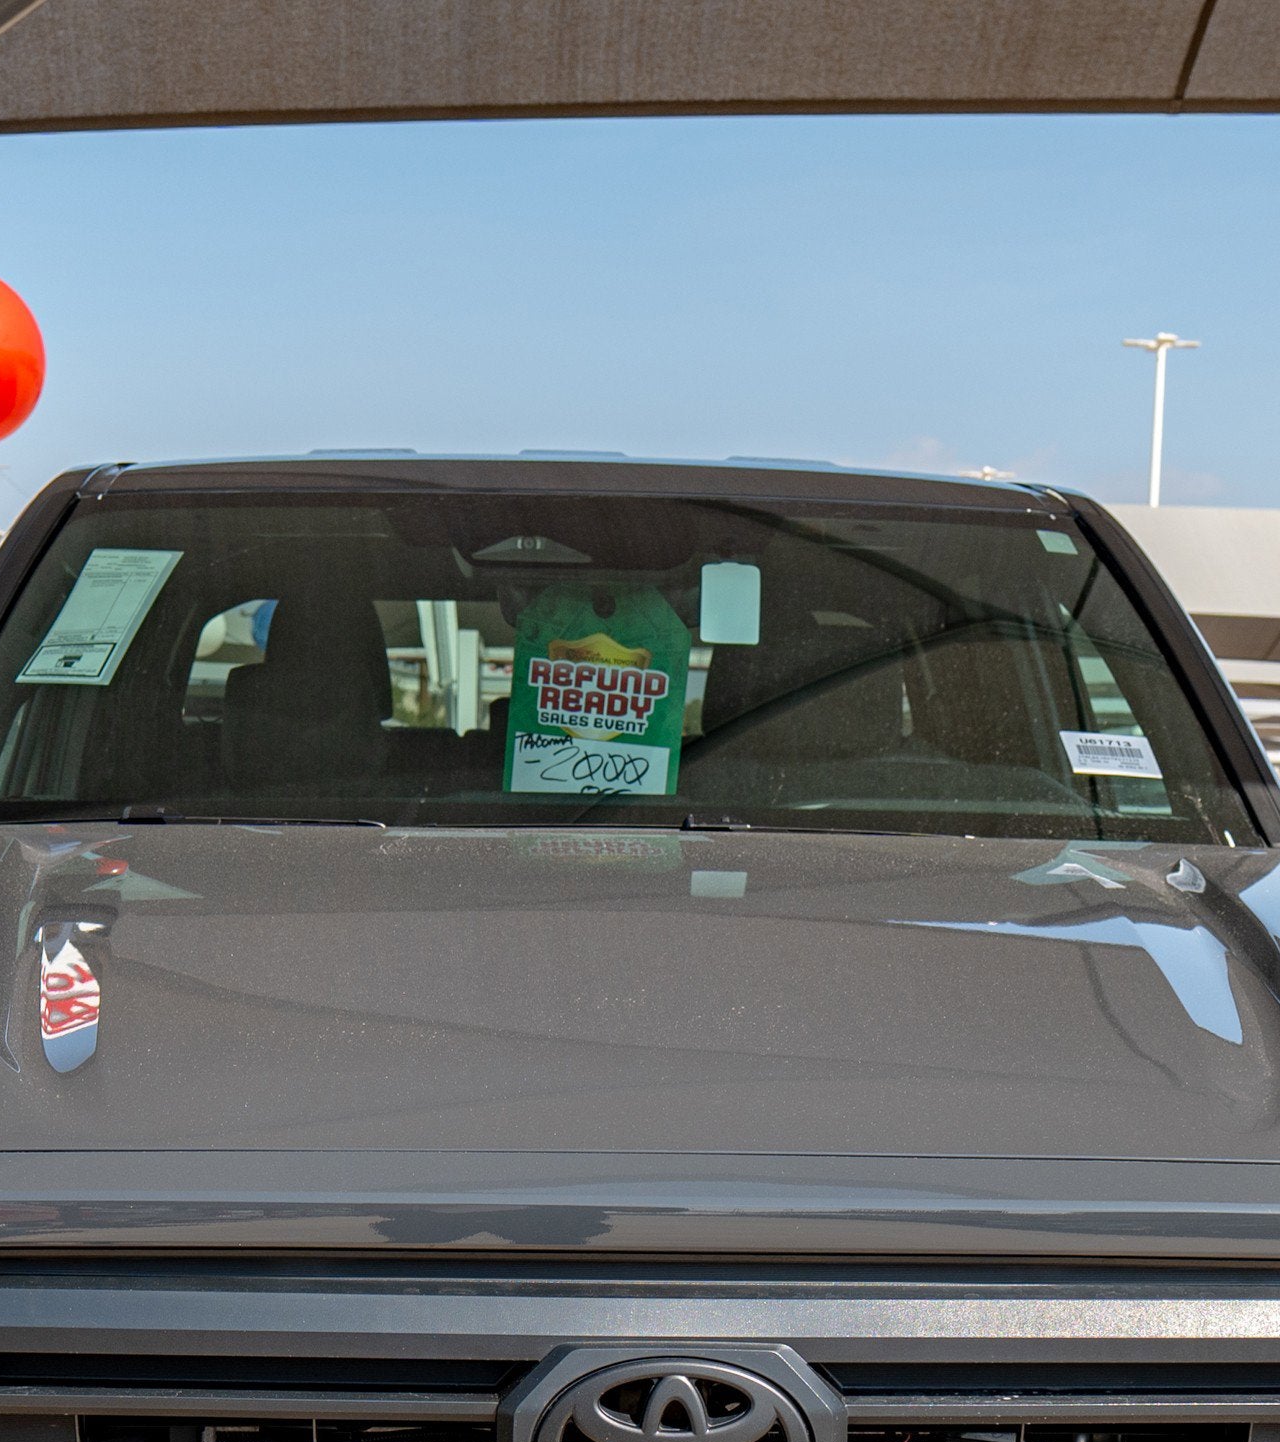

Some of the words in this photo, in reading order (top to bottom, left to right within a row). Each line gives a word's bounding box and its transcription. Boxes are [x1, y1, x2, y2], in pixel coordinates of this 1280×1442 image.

[530, 659, 668, 697] REFUND
[539, 686, 653, 720] READY
[540, 712, 589, 728] SALES
[593, 717, 647, 734] EVENT
